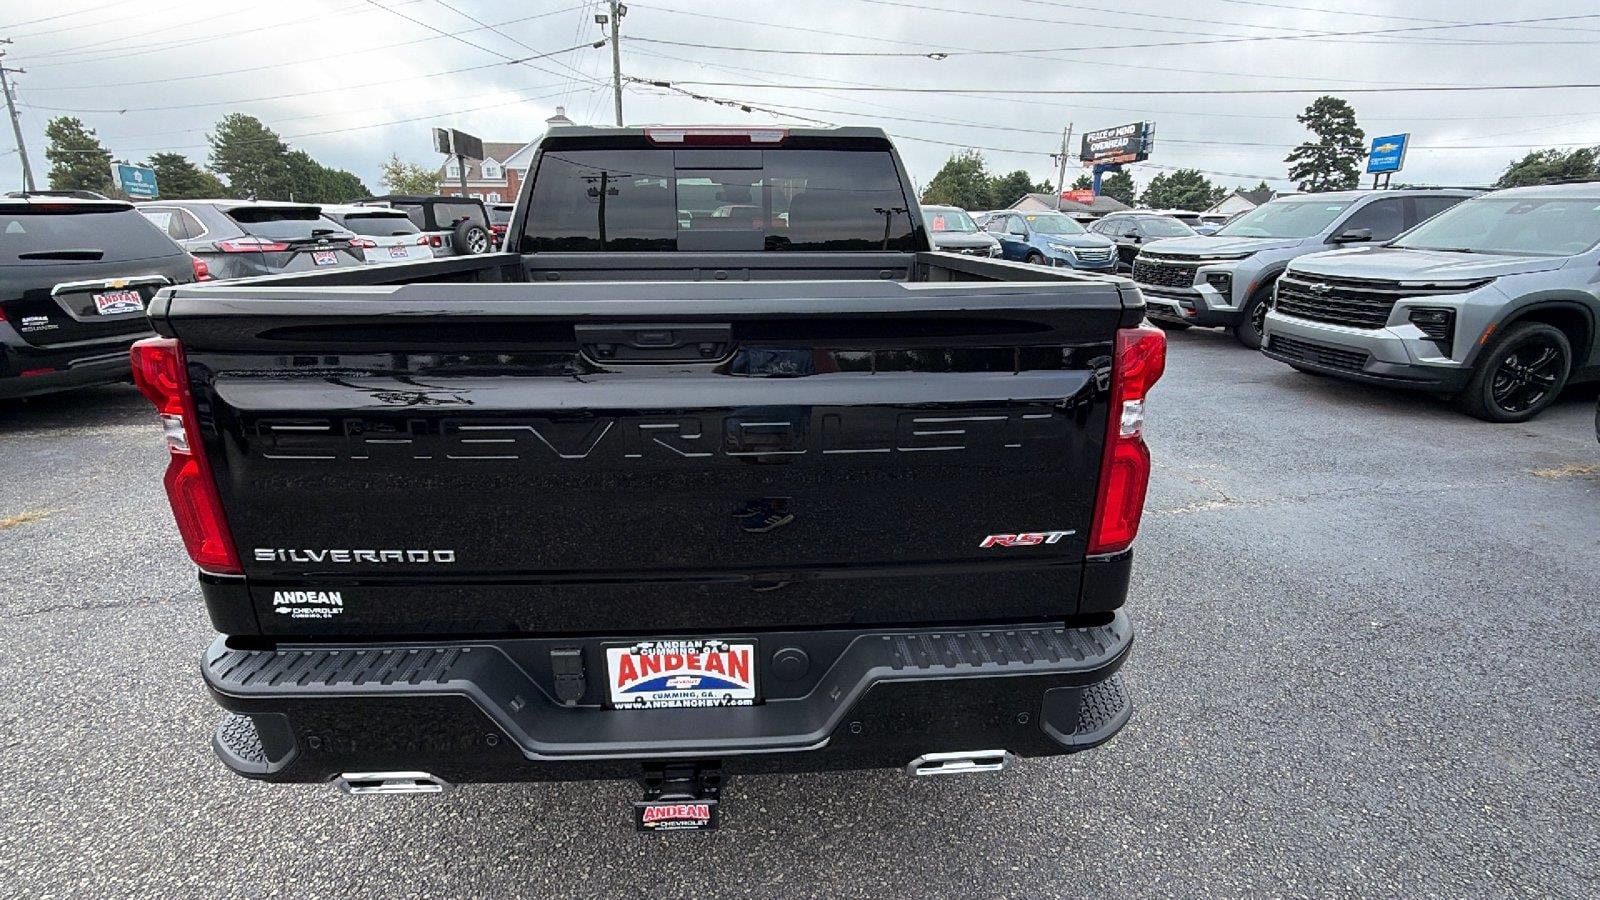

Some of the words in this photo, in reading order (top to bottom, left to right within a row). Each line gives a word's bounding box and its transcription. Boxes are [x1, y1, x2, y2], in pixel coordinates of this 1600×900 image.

[1087, 131, 1108, 142] PEACE
[1116, 125, 1136, 136] MIND
[1091, 138, 1129, 151] OVERHEAD
[98, 293, 139, 307] ANDEAN
[256, 413, 1055, 460] CHEVROLET
[979, 529, 1076, 548] RST
[254, 548, 456, 563] SILVERADO
[272, 591, 343, 606] ANDEAN
[656, 640, 703, 648] ANDEAN
[618, 650, 749, 688] ANDEAN
[614, 698, 753, 709] www.ANDEANCHEVY.com
[652, 692, 699, 700] CUMMING,
[643, 805, 710, 821] ANDEAN
